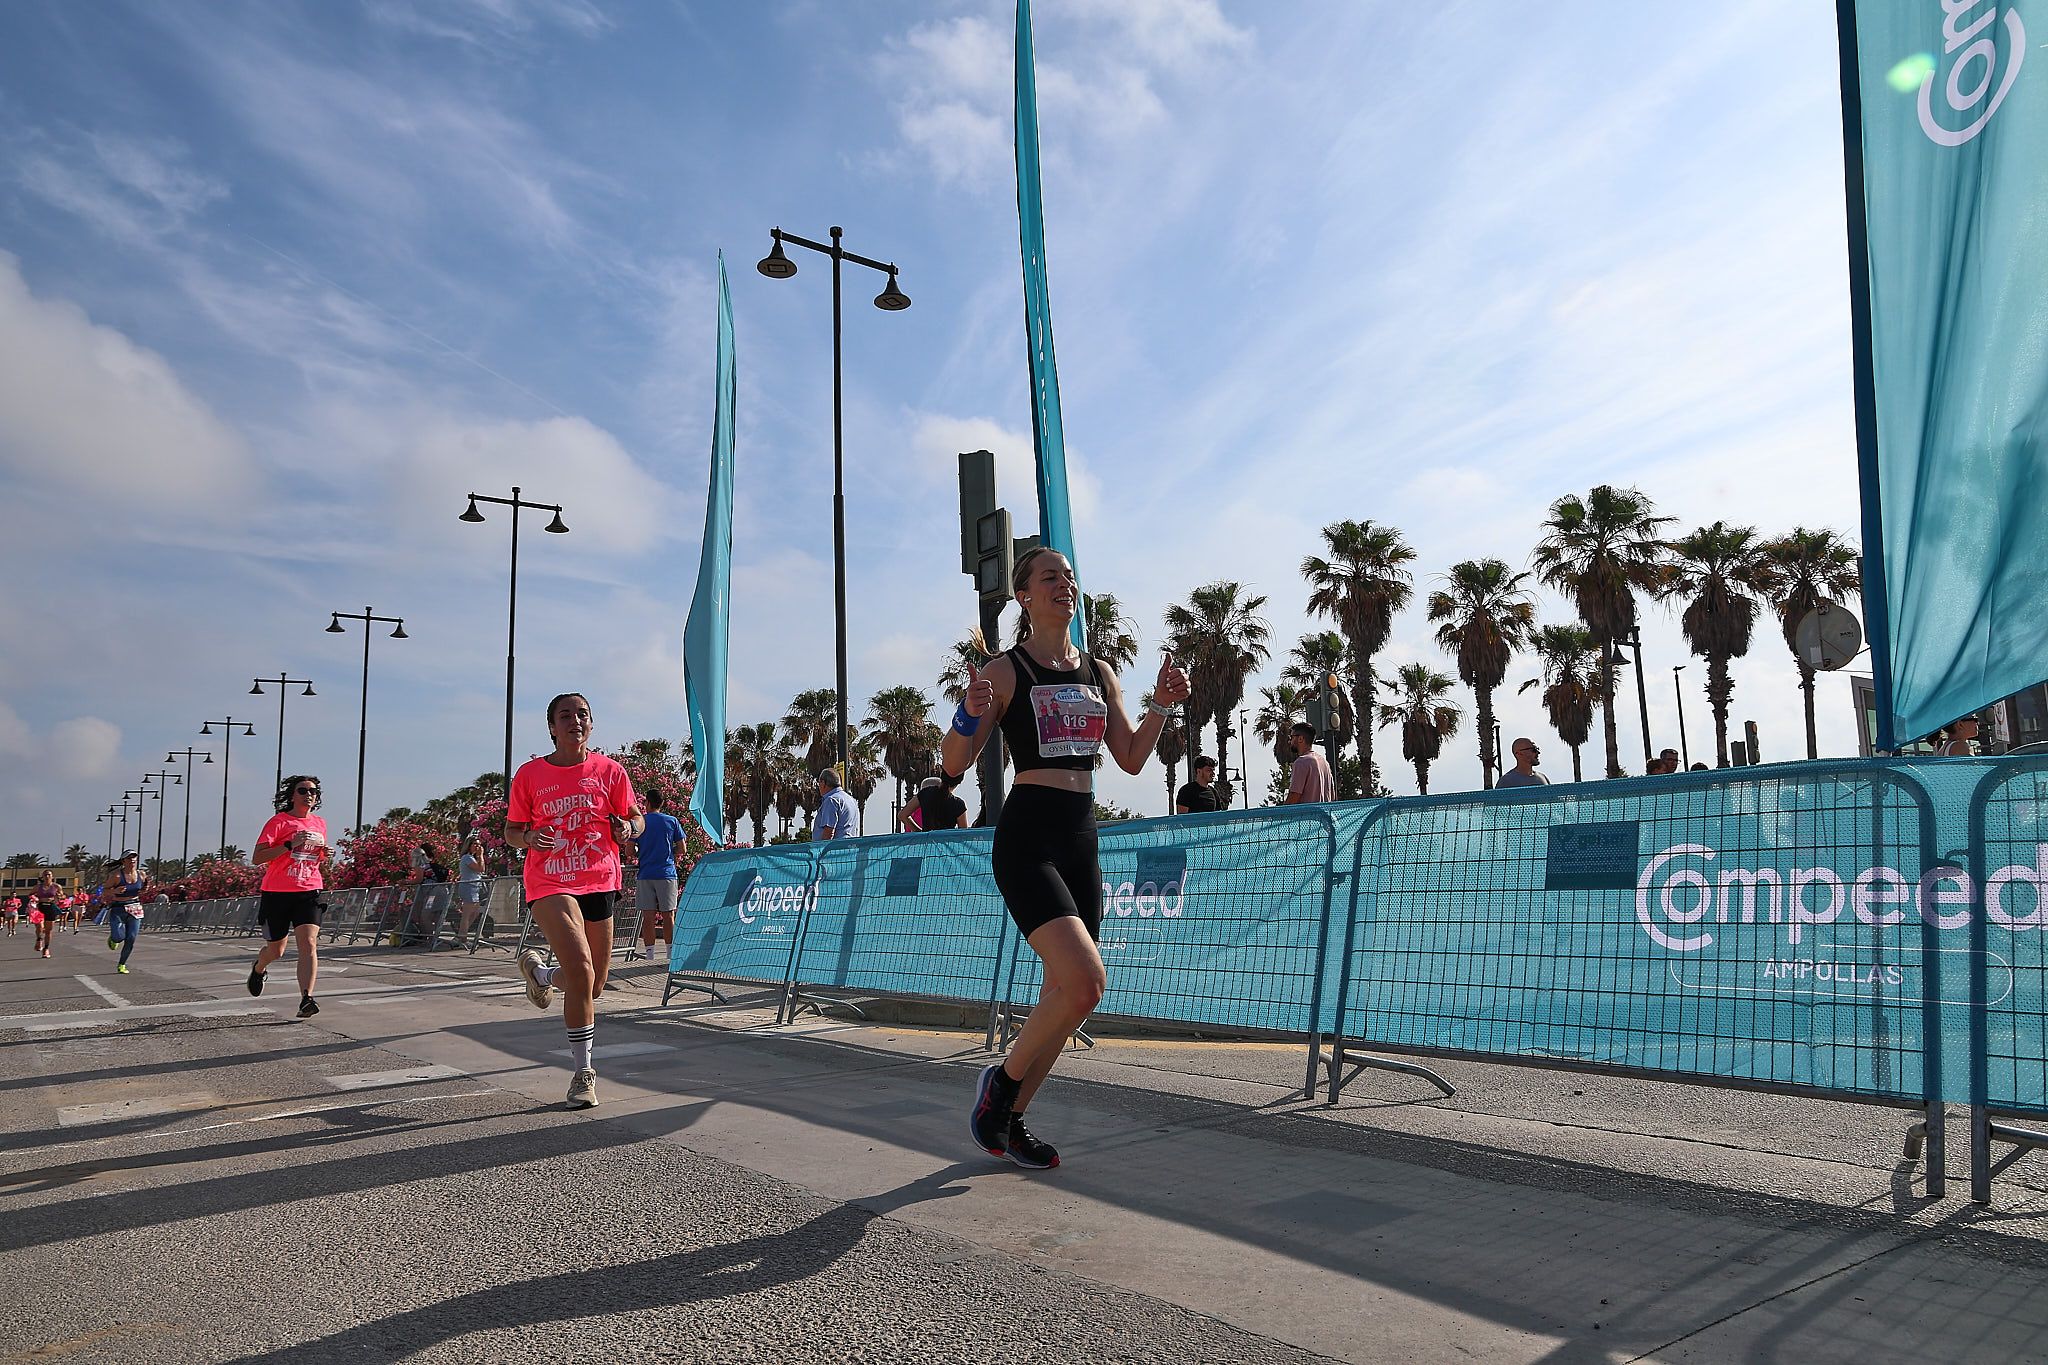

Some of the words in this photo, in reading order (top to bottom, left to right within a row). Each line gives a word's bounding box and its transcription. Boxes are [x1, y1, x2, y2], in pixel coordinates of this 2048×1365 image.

[1063, 715, 1088, 728] 016
[1048, 744, 1074, 753] OYSHO
[536, 784, 560, 797] OYSHO
[542, 793, 593, 816] CARRERA
[565, 838, 580, 857] LA
[544, 854, 588, 875] MUJER
[738, 875, 822, 924] Compeed
[1635, 842, 2048, 951] Compeed
[1763, 957, 1904, 985] AMPOLLAS
